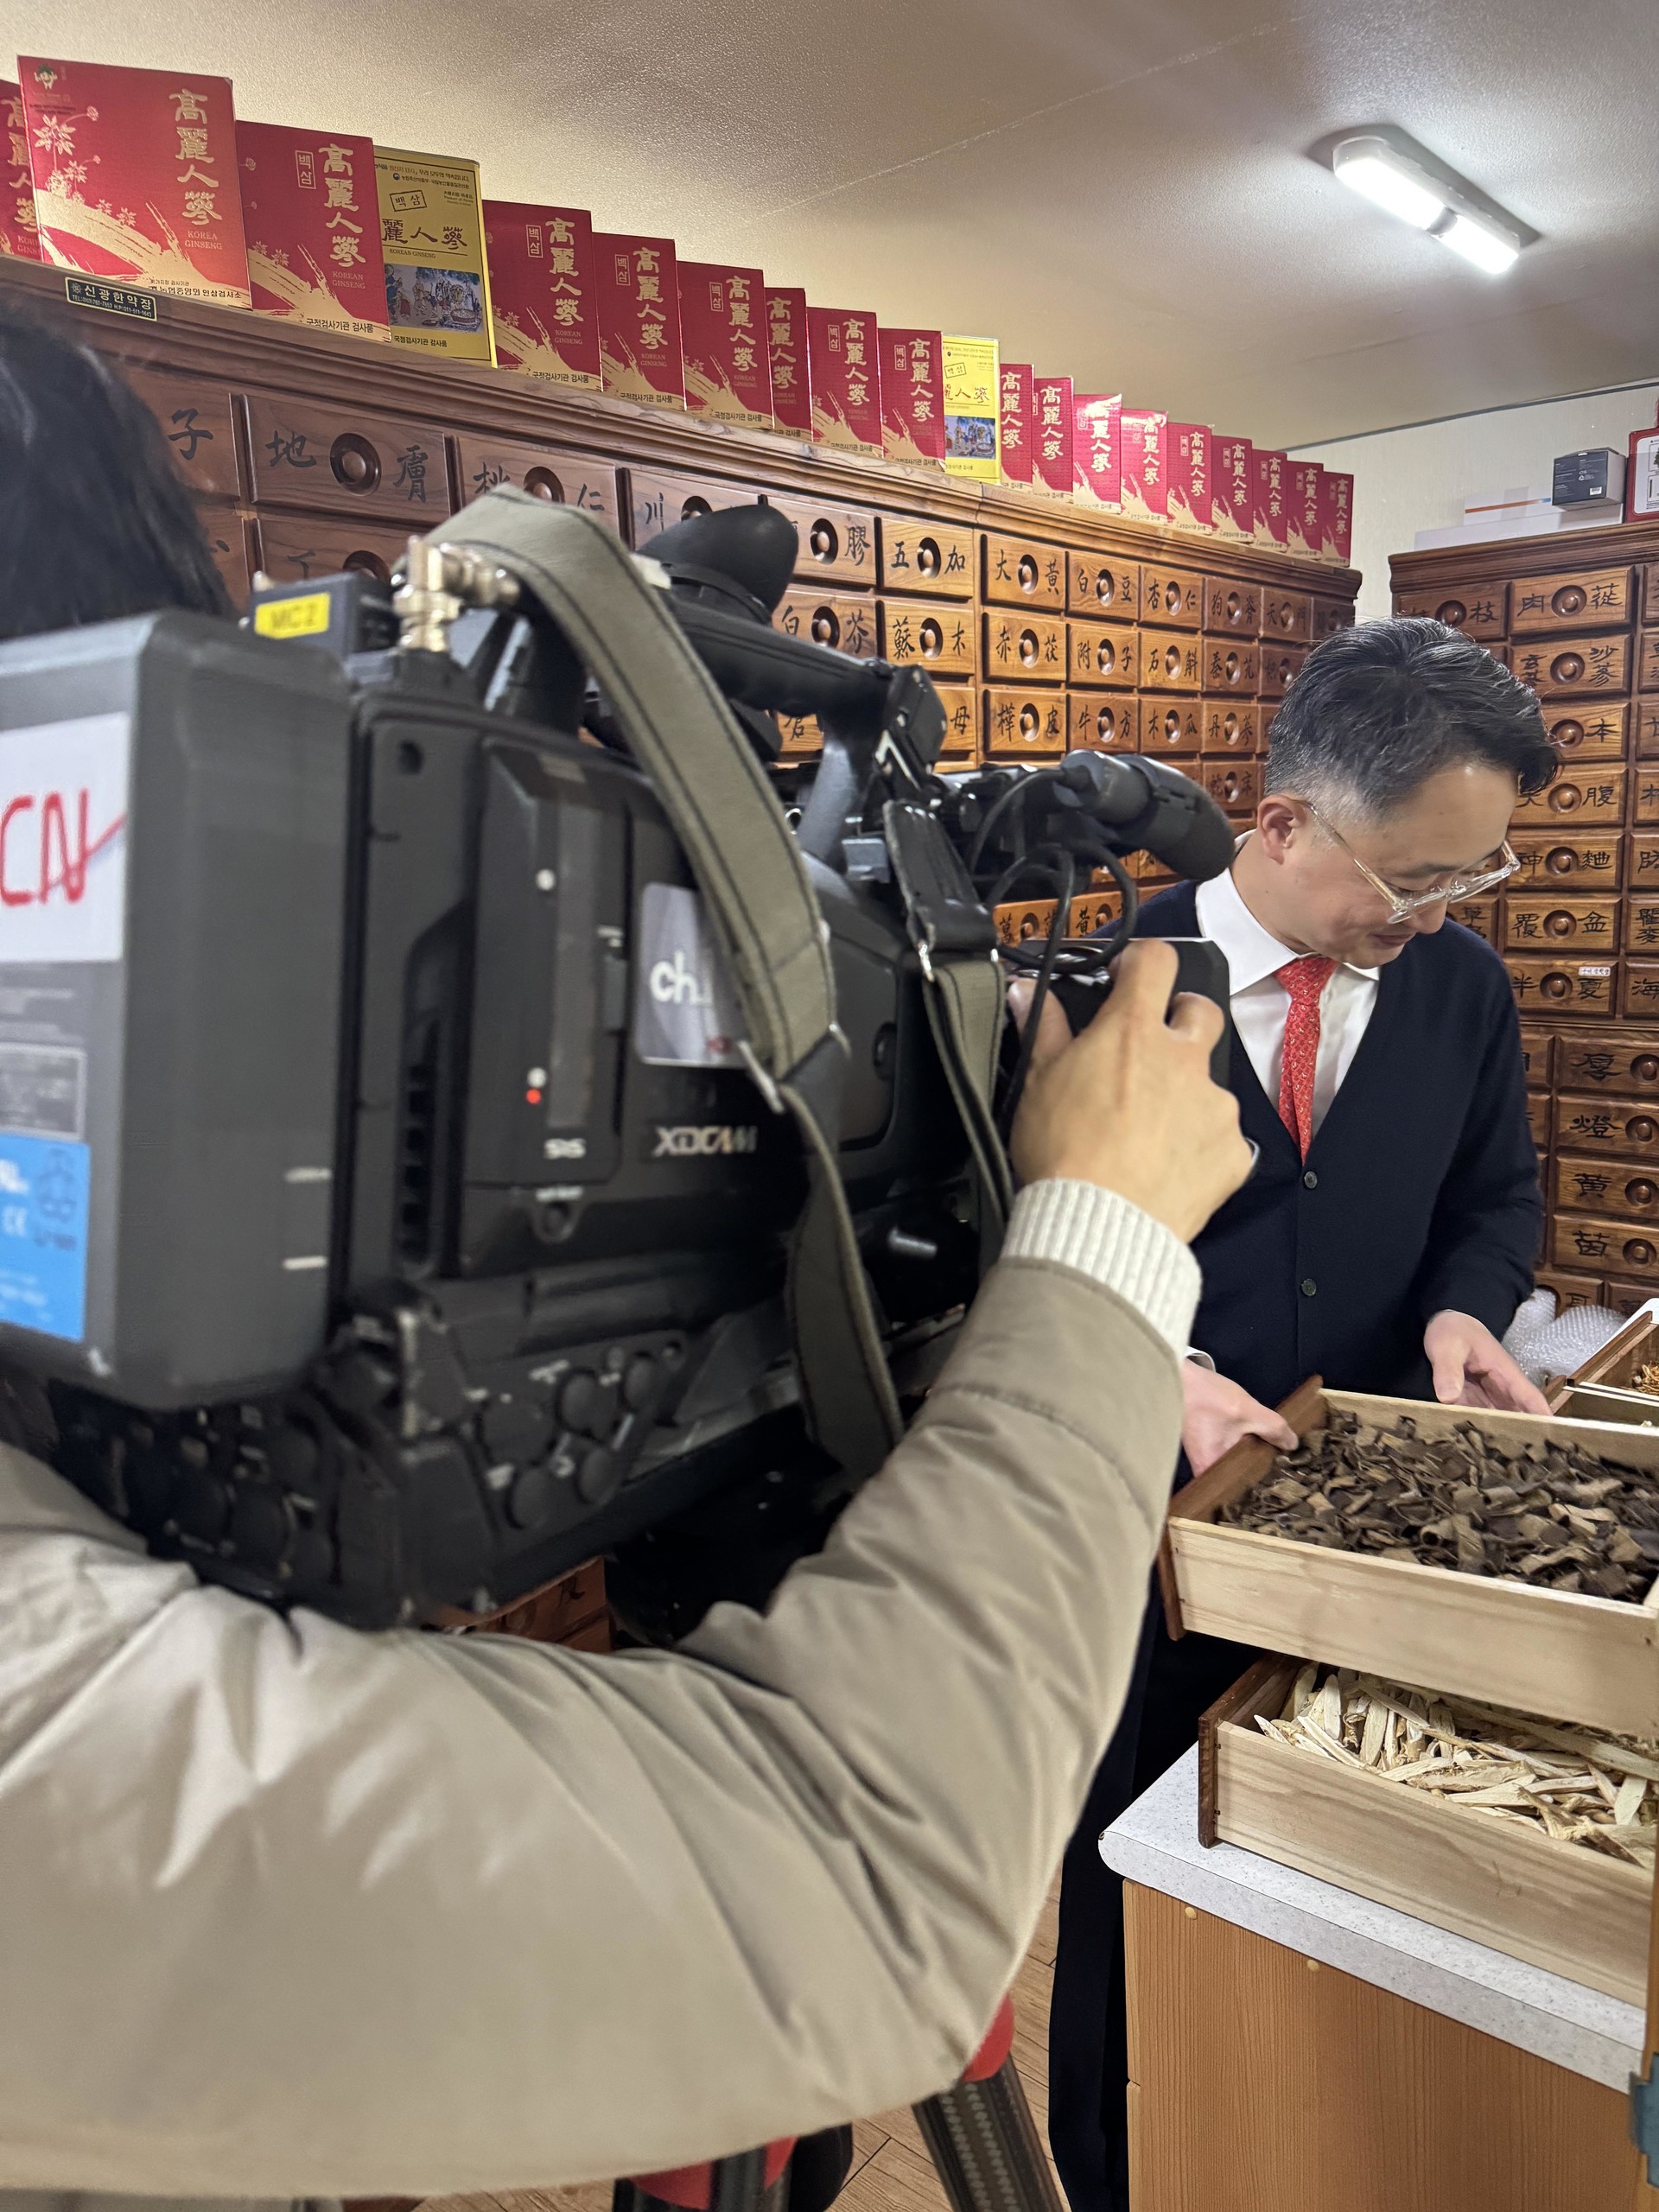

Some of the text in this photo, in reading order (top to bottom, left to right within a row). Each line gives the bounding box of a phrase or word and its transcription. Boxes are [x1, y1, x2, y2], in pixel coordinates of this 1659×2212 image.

[298, 155, 312, 185] 백삼
[185, 240, 223, 250] GINSENG
[529, 228, 541, 253] 백삼
[333, 271, 364, 281] KOREAN
[617, 257, 628, 282] 백삼
[332, 280, 365, 289] GINSENG
[353, 321, 374, 334] 검사품
[168, 408, 213, 460] 子
[1584, 718, 1620, 743] 本
[652, 1125, 758, 1158] XDCAM
